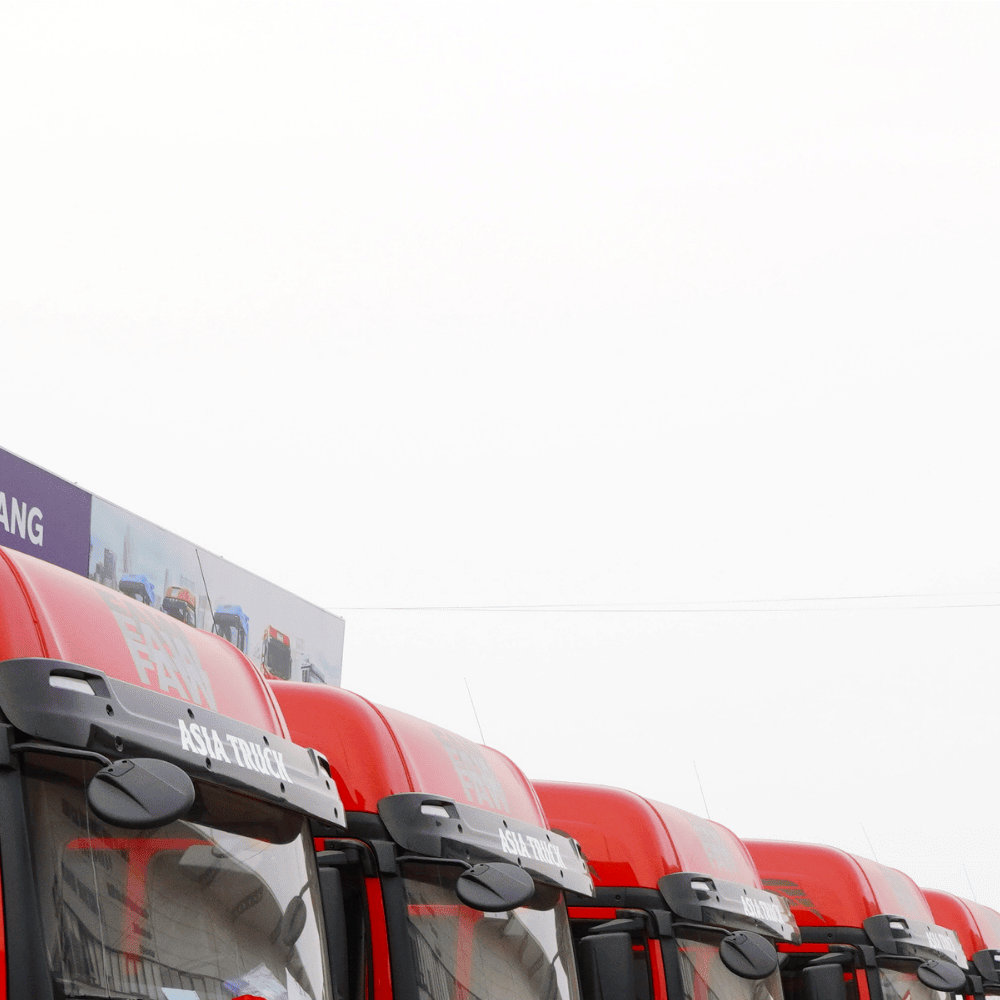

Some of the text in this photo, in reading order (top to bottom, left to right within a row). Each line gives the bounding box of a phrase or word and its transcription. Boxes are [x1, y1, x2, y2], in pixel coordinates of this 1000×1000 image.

[178, 719, 293, 783] ASIA TRUCK
[498, 828, 567, 869] ASIA TRUCK
